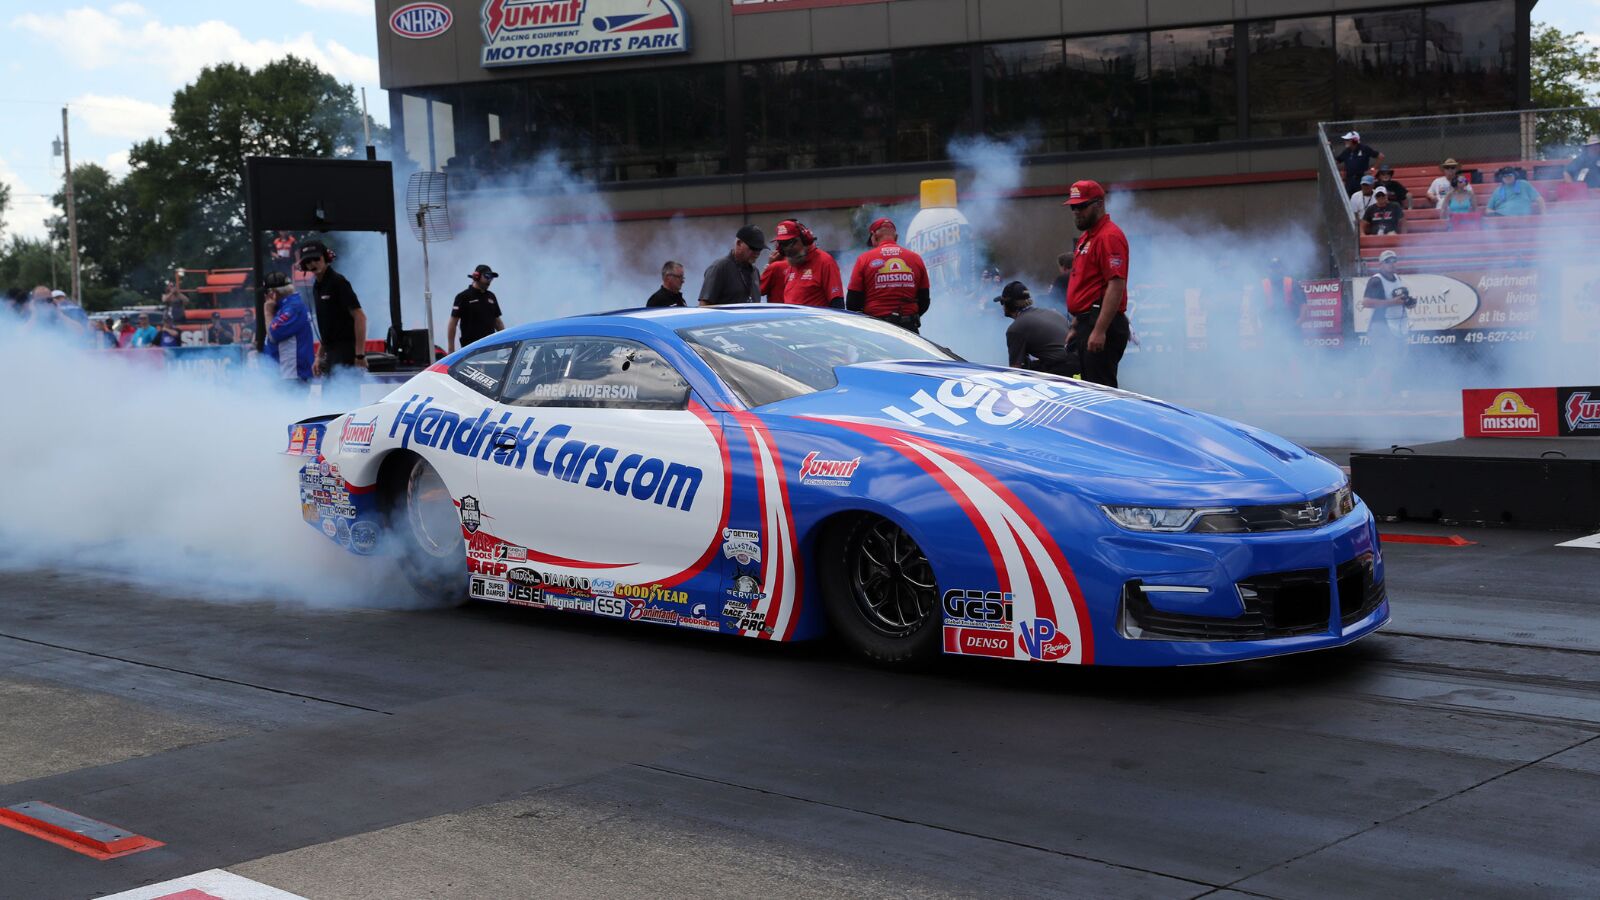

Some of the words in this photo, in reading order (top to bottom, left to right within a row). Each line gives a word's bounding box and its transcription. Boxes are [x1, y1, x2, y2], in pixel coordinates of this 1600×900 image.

[400, 9, 444, 32] NHRA
[488, 0, 581, 35] SUMMIT
[500, 33, 530, 41] RACING
[532, 30, 580, 40] EQUIPMENT
[485, 37, 621, 61] MOTORSPORTS
[628, 33, 679, 49] PARK
[1477, 274, 1537, 289] Apartment
[1506, 292, 1537, 305] living
[1437, 304, 1459, 314] LLC
[1478, 312, 1489, 322] at
[1492, 310, 1506, 321] its
[516, 375, 530, 384] PRO
[534, 383, 567, 399] GREG
[568, 383, 638, 400] ANDERSON
[339, 415, 377, 447] SUMMIT
[389, 394, 703, 512] HendrickCars.com
[799, 451, 860, 483] SUMMIT
[467, 557, 507, 576] ARP
[472, 579, 485, 596] ATI
[488, 582, 504, 590] SUPER
[542, 573, 590, 590] DIAMOND
[485, 589, 506, 598] DAMPER
[509, 585, 545, 604] JESEL
[726, 590, 766, 600] SERVICE
[546, 594, 594, 611] MagnaFuel
[597, 599, 623, 615] ESS
[679, 616, 720, 627] GOODRIDGE
[723, 608, 743, 617] RACE
[745, 611, 765, 621] STAR
[740, 619, 766, 631] PRO
[966, 636, 1008, 649] DENSO
[1019, 618, 1056, 660] VP
[1042, 642, 1072, 655] Racing
